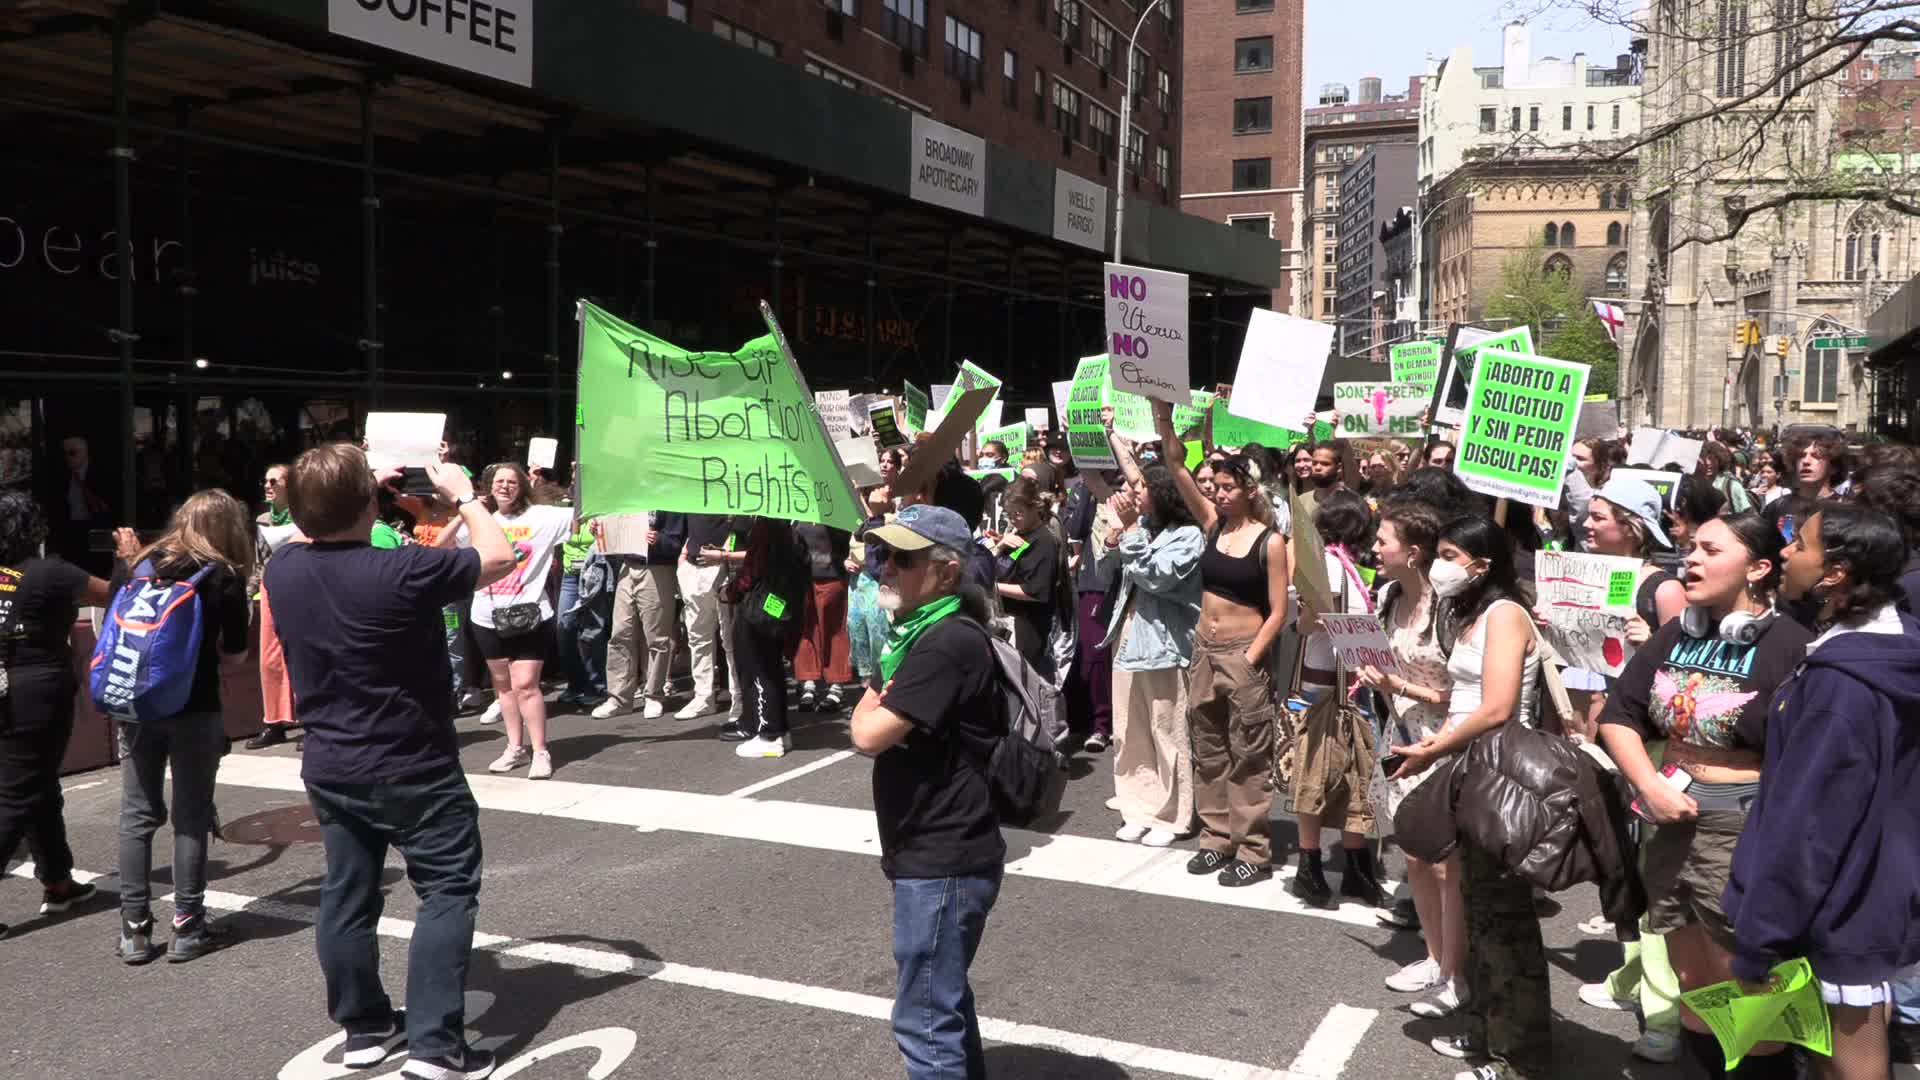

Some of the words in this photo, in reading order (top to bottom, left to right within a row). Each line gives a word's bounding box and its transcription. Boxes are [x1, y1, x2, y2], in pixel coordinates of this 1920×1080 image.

[925, 138, 974, 169] BROADWAY
[918, 164, 979, 197] APOTHECARY
[1068, 190, 1096, 214] WELLS
[1066, 212, 1095, 235] FARGO
[249, 249, 321, 285] juice
[1110, 273, 1147, 302] NO
[1119, 302, 1183, 341] Uterus
[1112, 332, 1149, 360] NO
[1397, 346, 1432, 358] ABORTION
[1120, 361, 1176, 392] Opinion
[1407, 358, 1438, 369] DEMAND
[1485, 361, 1555, 393] ¡ABORTO
[1557, 373, 1572, 395] A
[1383, 385, 1425, 399] TREAD
[1481, 388, 1564, 422] SOLICITUD
[664, 389, 816, 443] Abortion
[1072, 408, 1083, 424] SIN
[1343, 414, 1369, 433] ON
[1389, 415, 1420, 433] ME
[1471, 415, 1482, 434] Y
[1484, 417, 1511, 442] SIN
[1513, 424, 1565, 453] PEDIR
[1463, 441, 1559, 481] DISCULPAS!
